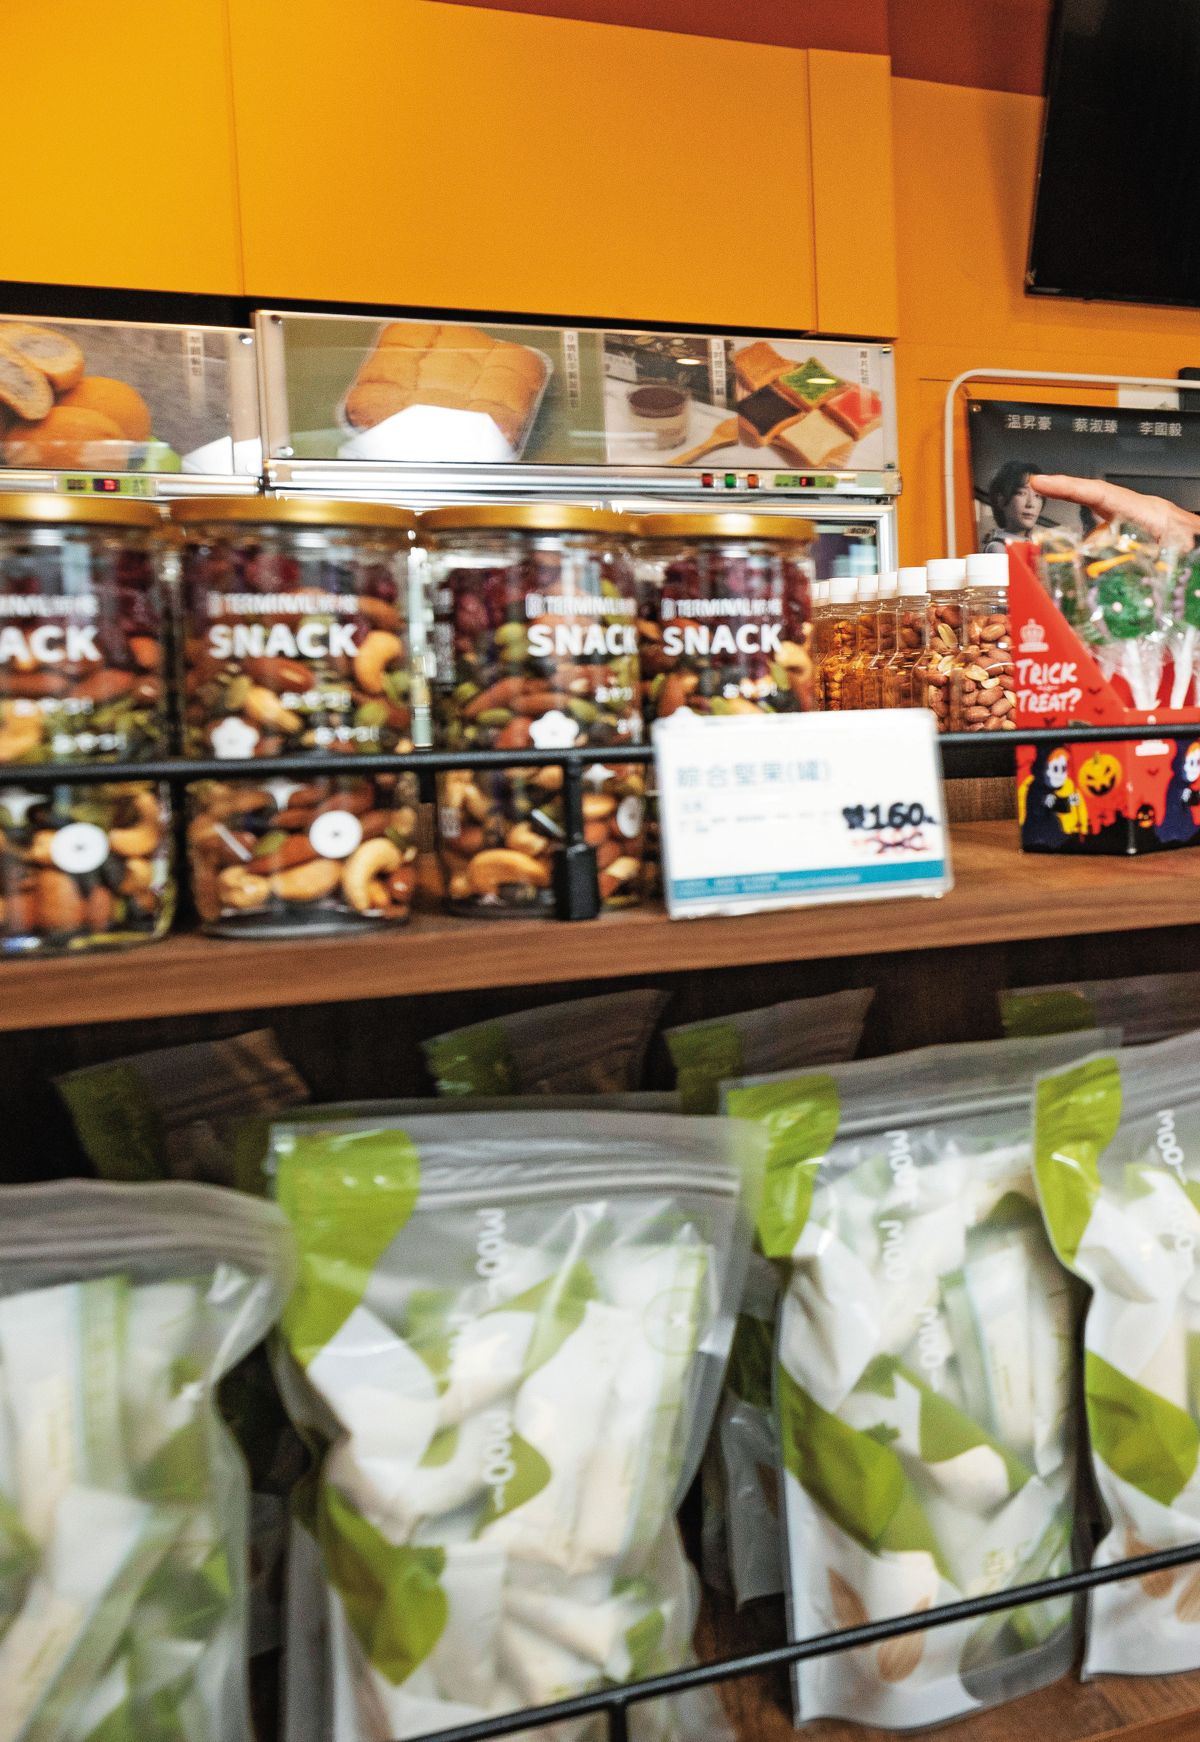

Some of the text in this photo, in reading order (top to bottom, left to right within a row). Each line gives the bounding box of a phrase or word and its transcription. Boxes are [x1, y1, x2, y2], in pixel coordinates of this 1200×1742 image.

[1072, 417, 1118, 434] 蔡淑臻
[1138, 421, 1183, 437] 李國毅
[209, 623, 358, 659] SNACK
[663, 623, 782, 656] SNACK
[1016, 658, 1078, 686] TRICK
[1016, 687, 1082, 713] TREAT?
